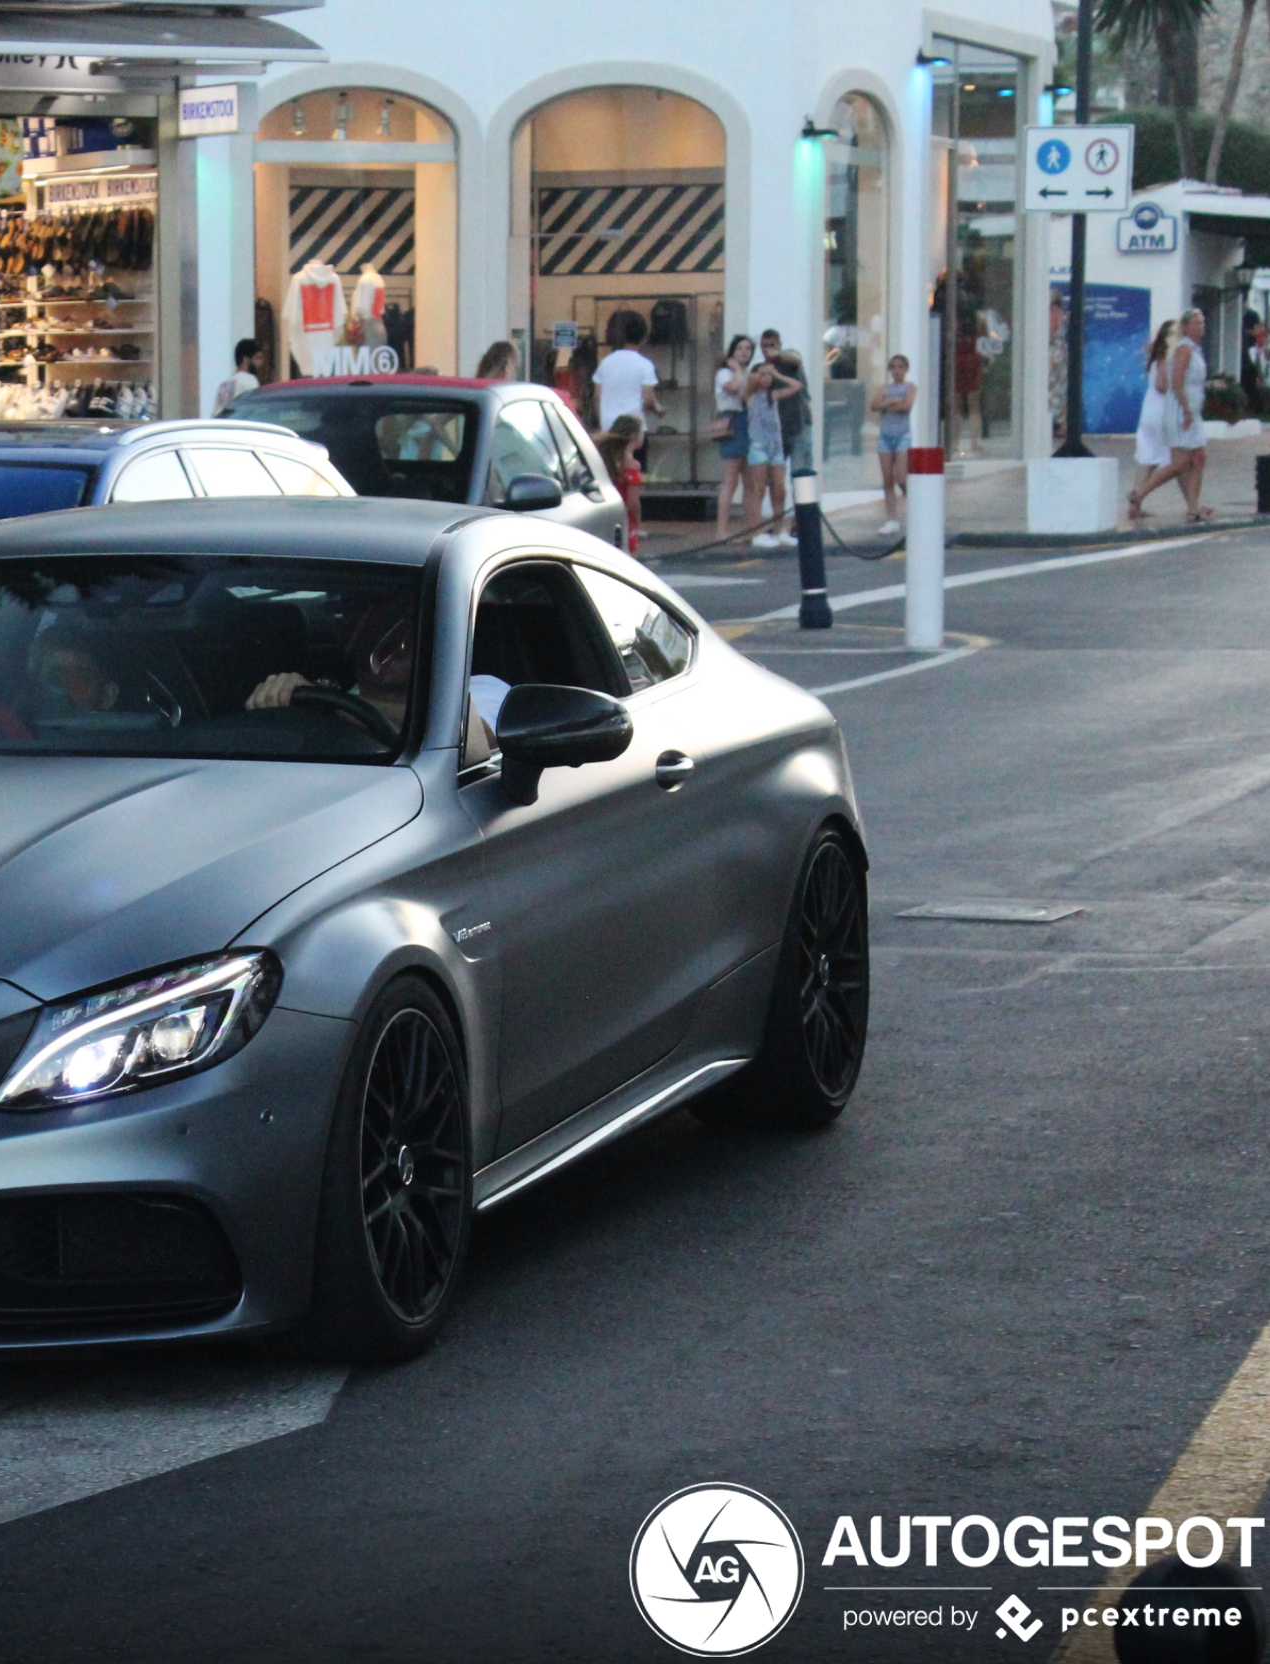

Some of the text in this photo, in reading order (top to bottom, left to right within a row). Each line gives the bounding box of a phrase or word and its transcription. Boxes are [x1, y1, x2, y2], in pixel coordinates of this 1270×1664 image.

[182, 99, 235, 121] BIRKENSTOCK
[49, 182, 99, 202] BIRKENSTOCK
[1128, 234, 1166, 248] ATM
